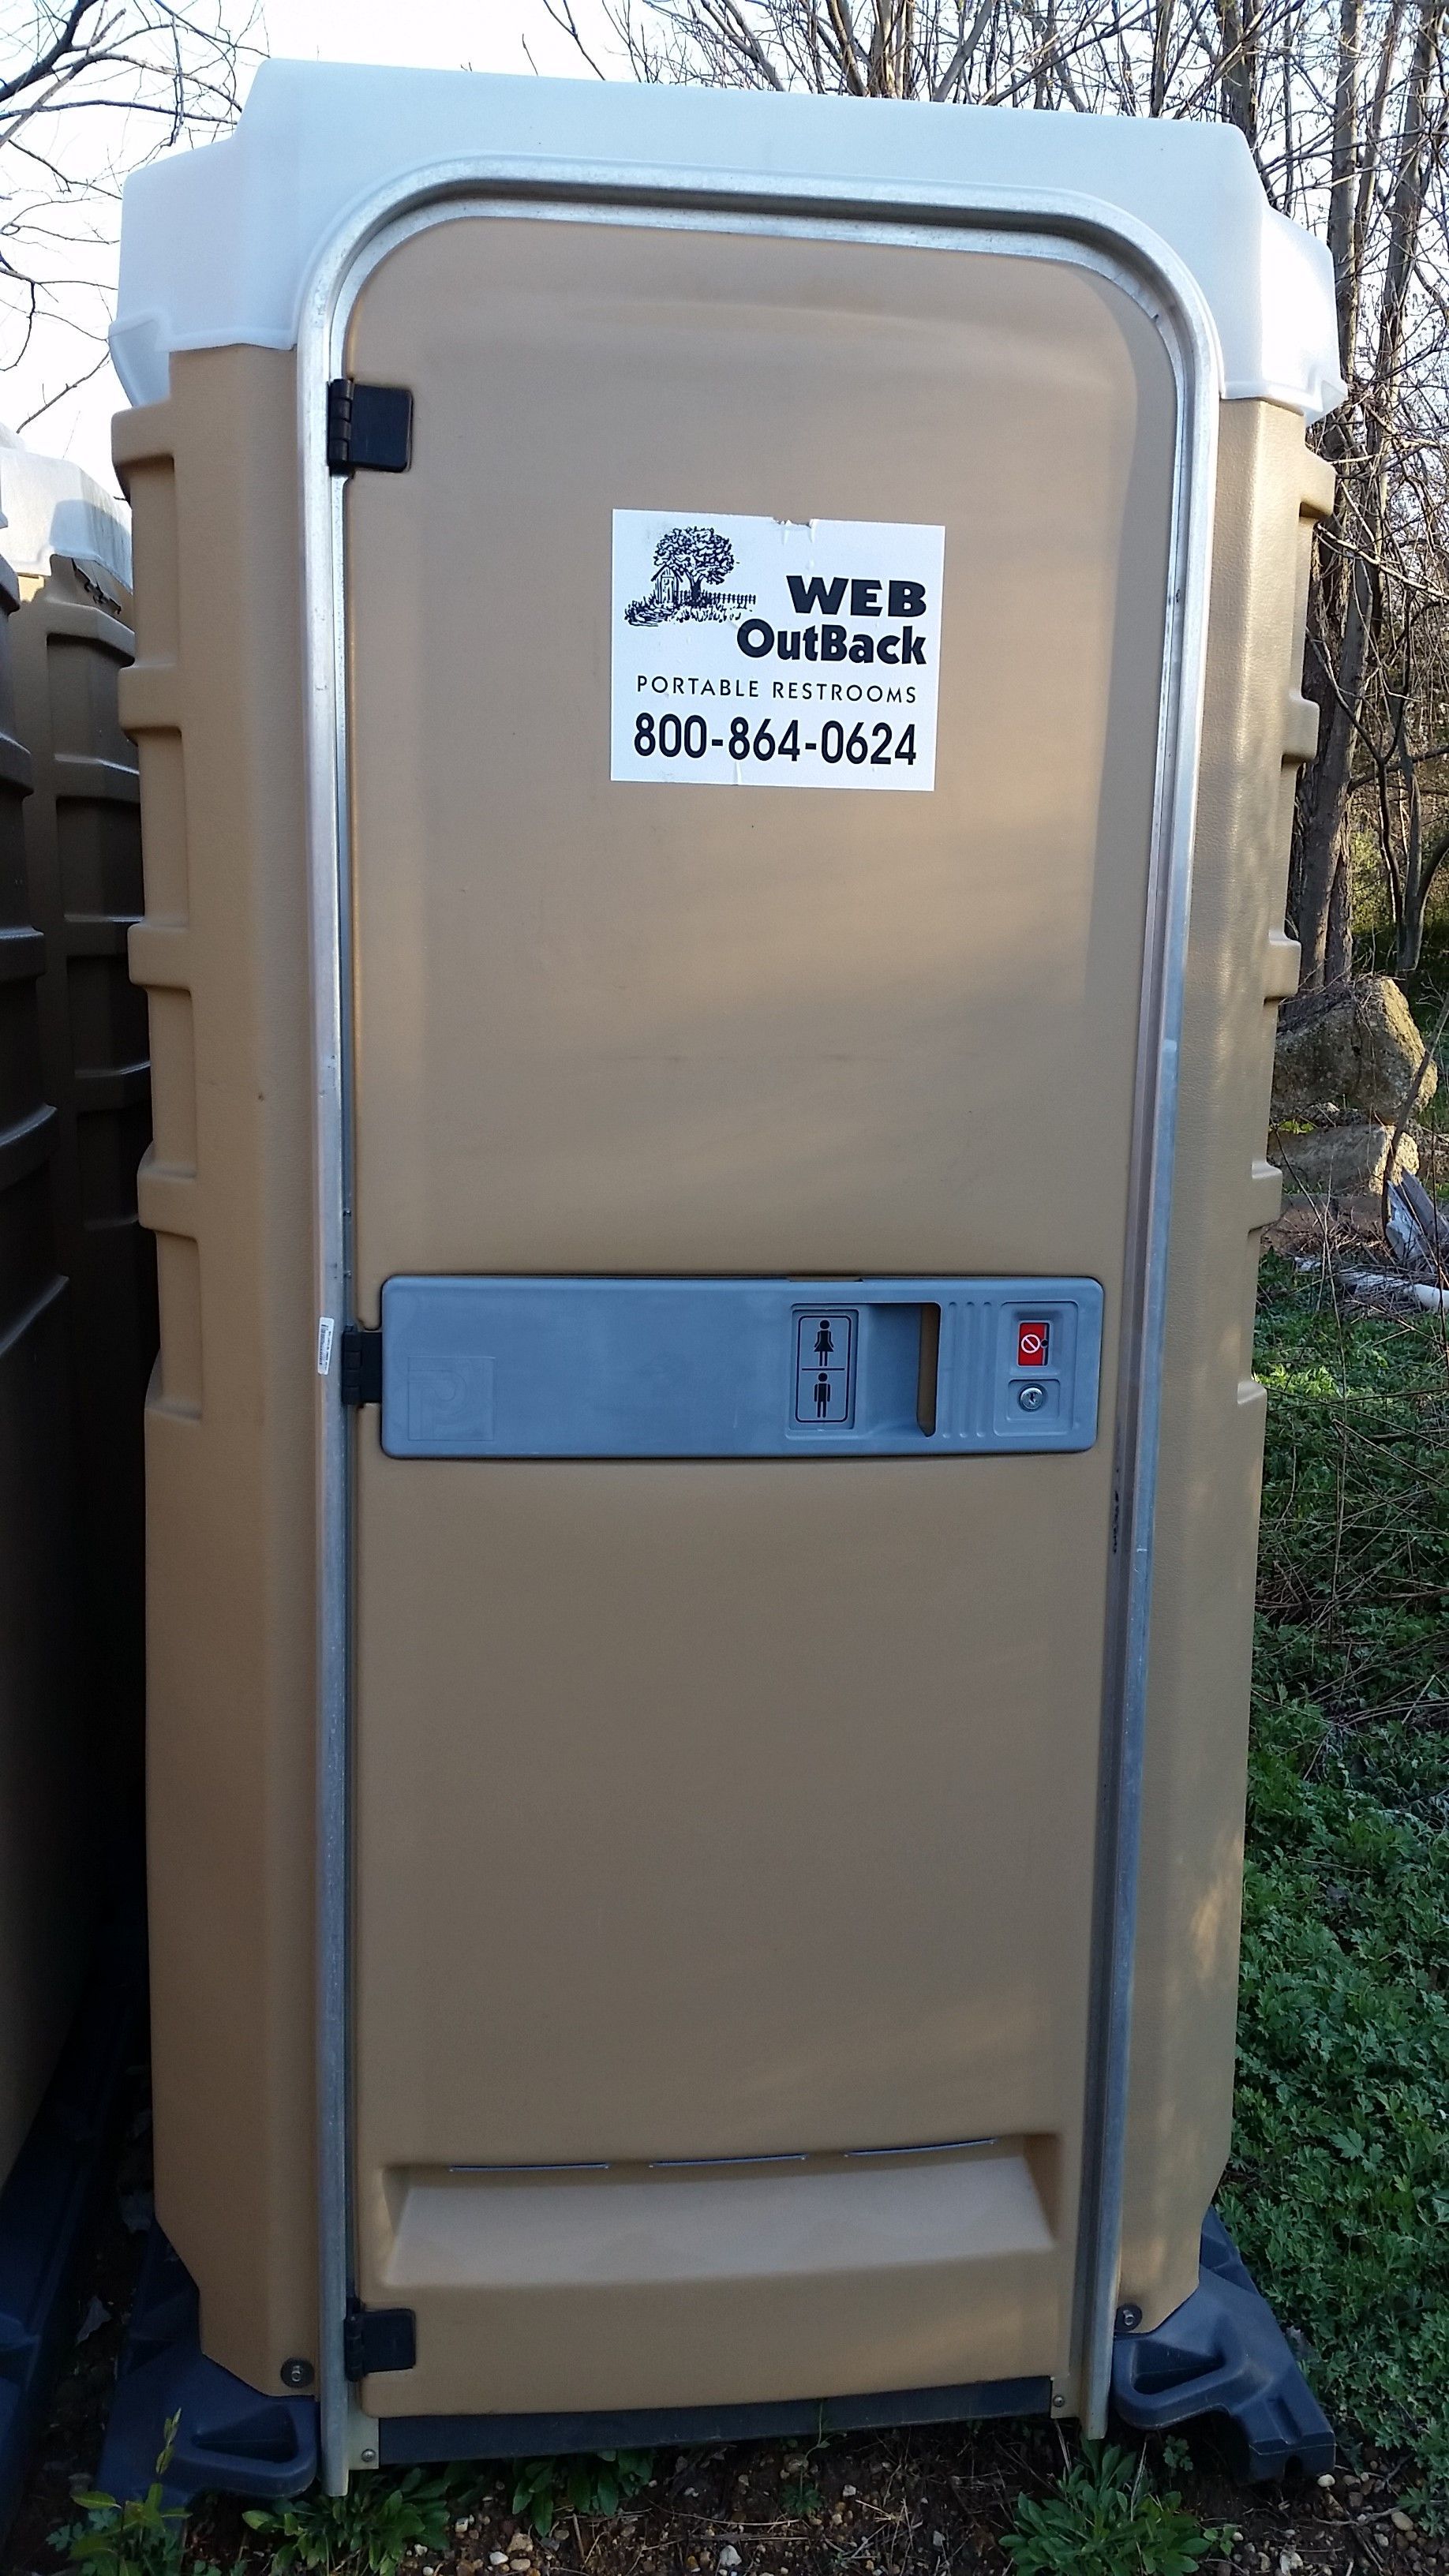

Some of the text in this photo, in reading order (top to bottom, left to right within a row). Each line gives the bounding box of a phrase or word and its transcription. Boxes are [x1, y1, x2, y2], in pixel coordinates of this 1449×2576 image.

[785, 575, 927, 618] WEB
[736, 618, 927, 665] OutBack
[637, 675, 916, 703] PORTABLE RESTROOMS
[634, 712, 917, 766] 800-864-0624
